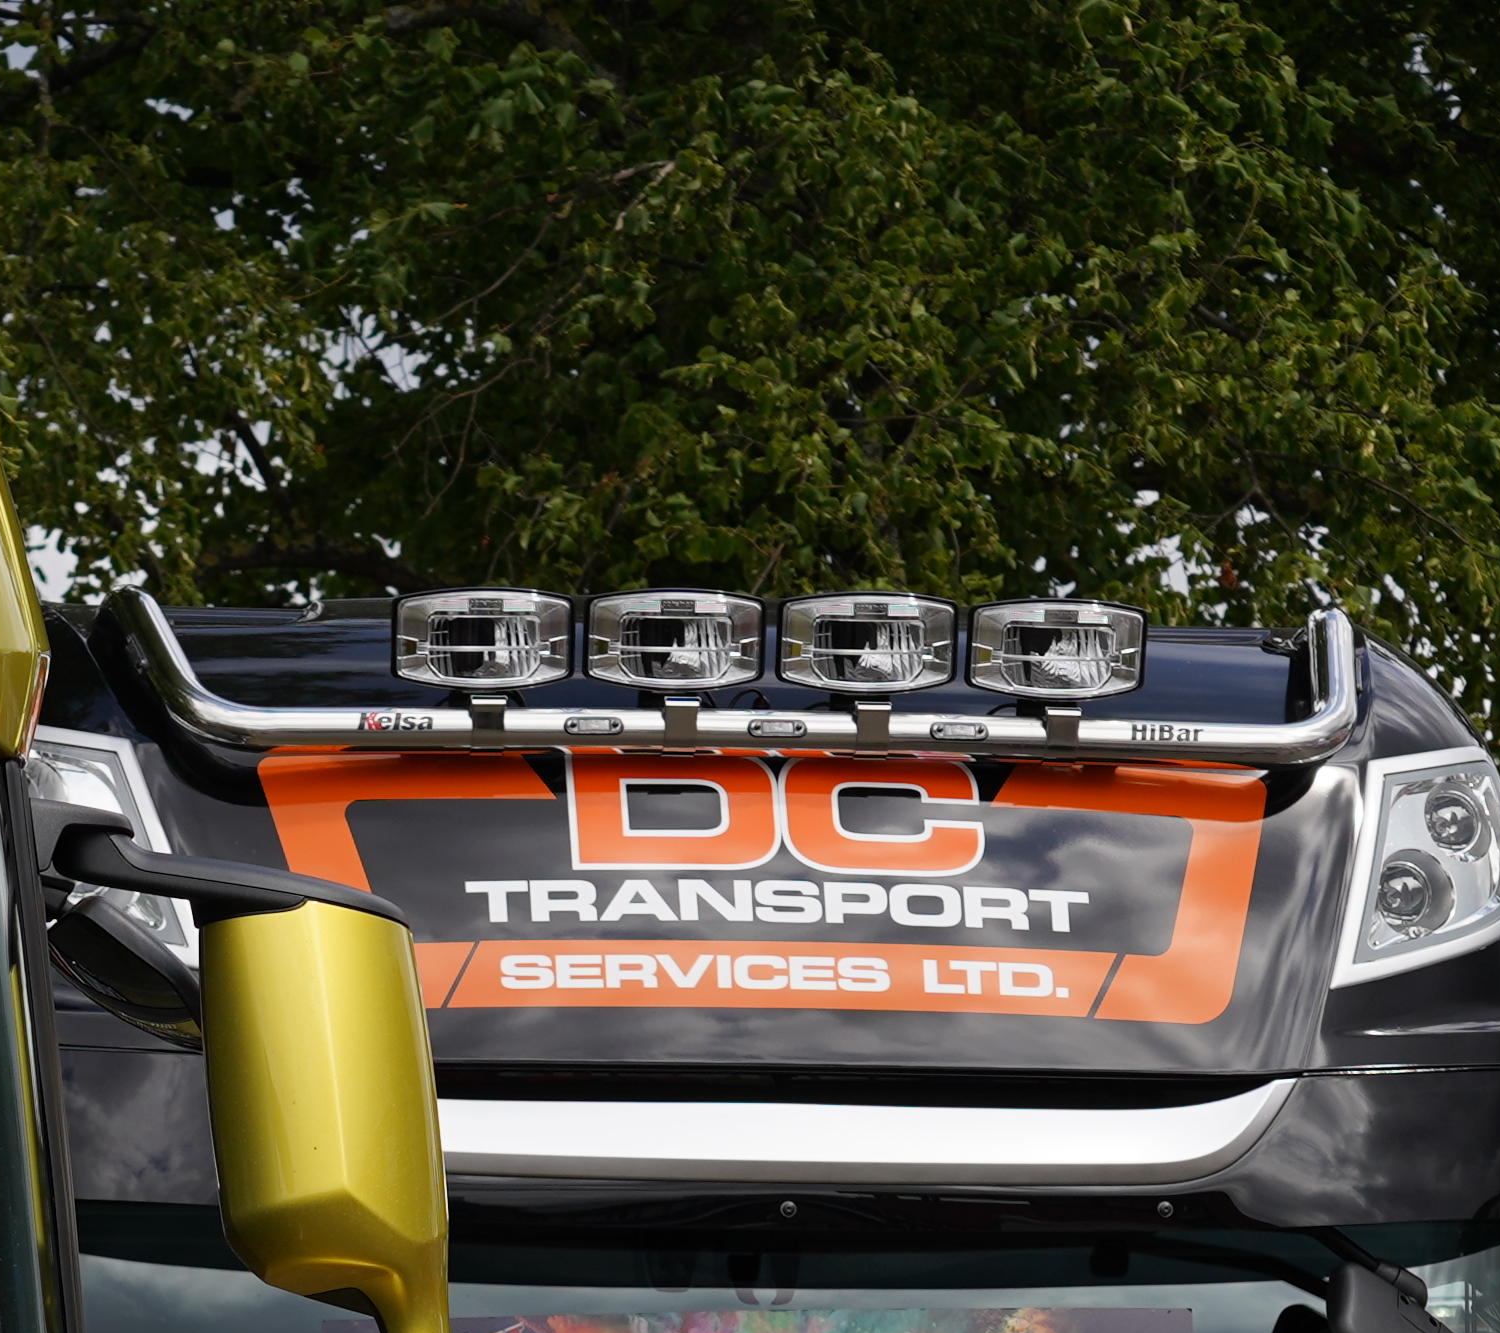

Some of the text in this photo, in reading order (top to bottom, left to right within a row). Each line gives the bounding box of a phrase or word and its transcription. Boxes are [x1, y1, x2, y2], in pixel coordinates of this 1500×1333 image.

[357, 712, 434, 730] Kelsa
[1131, 724, 1204, 742] HiBar
[562, 748, 986, 877] DC
[465, 879, 1090, 932] TRANSPORT
[500, 954, 1070, 998] SERVICES LTD.
